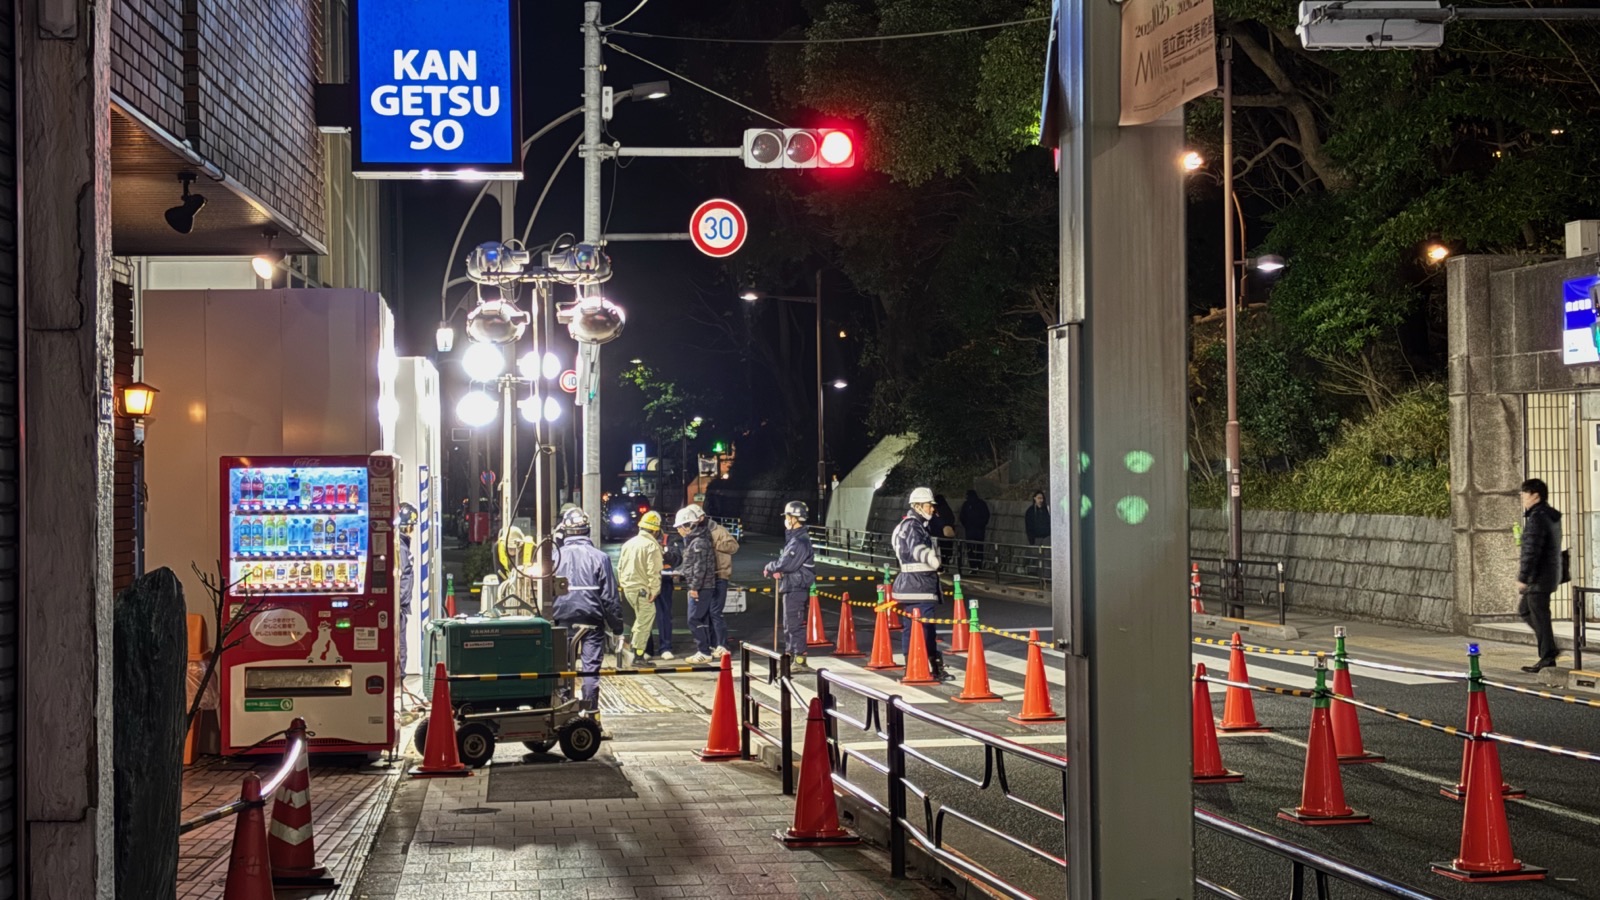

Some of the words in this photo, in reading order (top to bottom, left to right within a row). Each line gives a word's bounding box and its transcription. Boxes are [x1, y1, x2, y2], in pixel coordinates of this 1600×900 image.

[393, 49, 477, 81] KAN
[370, 84, 500, 117] GETSU
[409, 118, 465, 151] SO
[704, 216, 733, 240] 30
[635, 446, 643, 456] P
